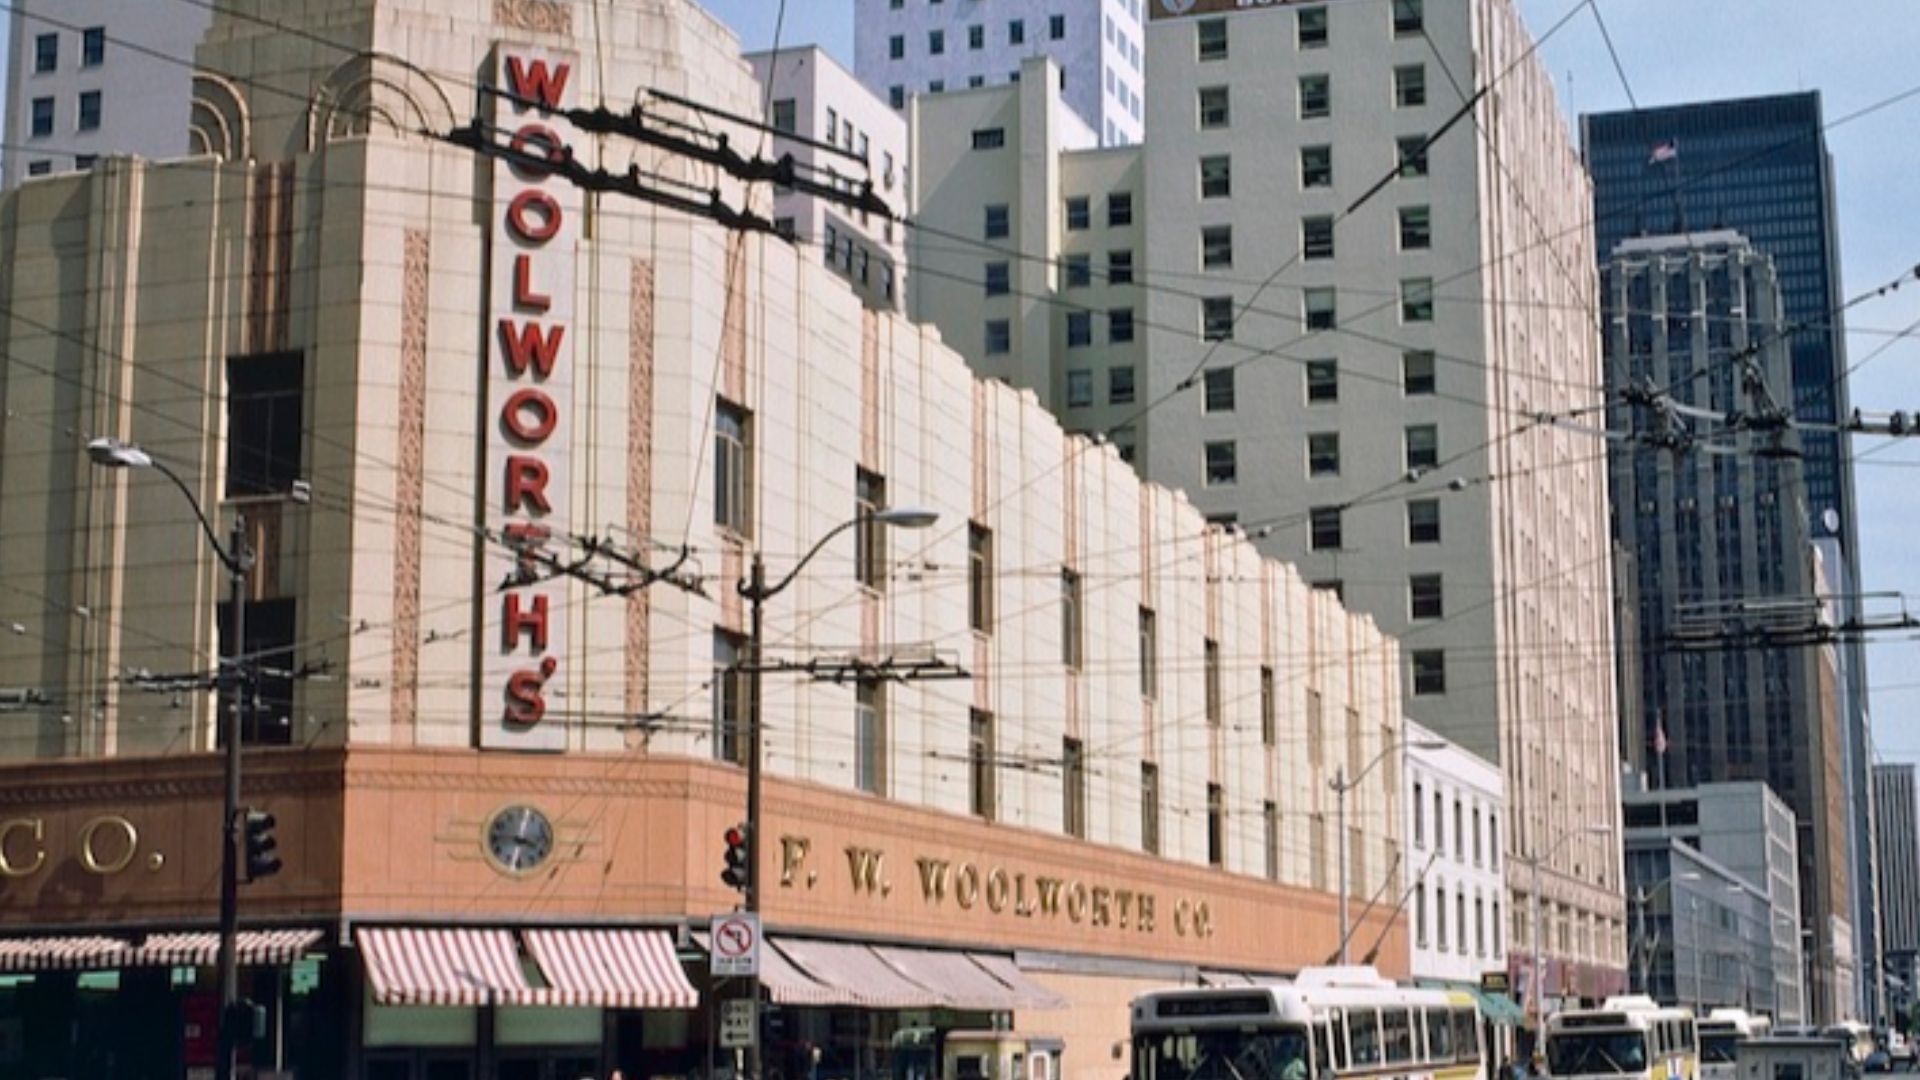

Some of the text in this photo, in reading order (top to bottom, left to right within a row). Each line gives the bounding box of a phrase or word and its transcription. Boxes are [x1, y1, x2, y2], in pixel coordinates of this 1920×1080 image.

[499, 55, 570, 724] WOOLWORTH'S
[0, 815, 165, 876] CO.
[780, 834, 1213, 938] F. W. WOOLWORTH CO.
